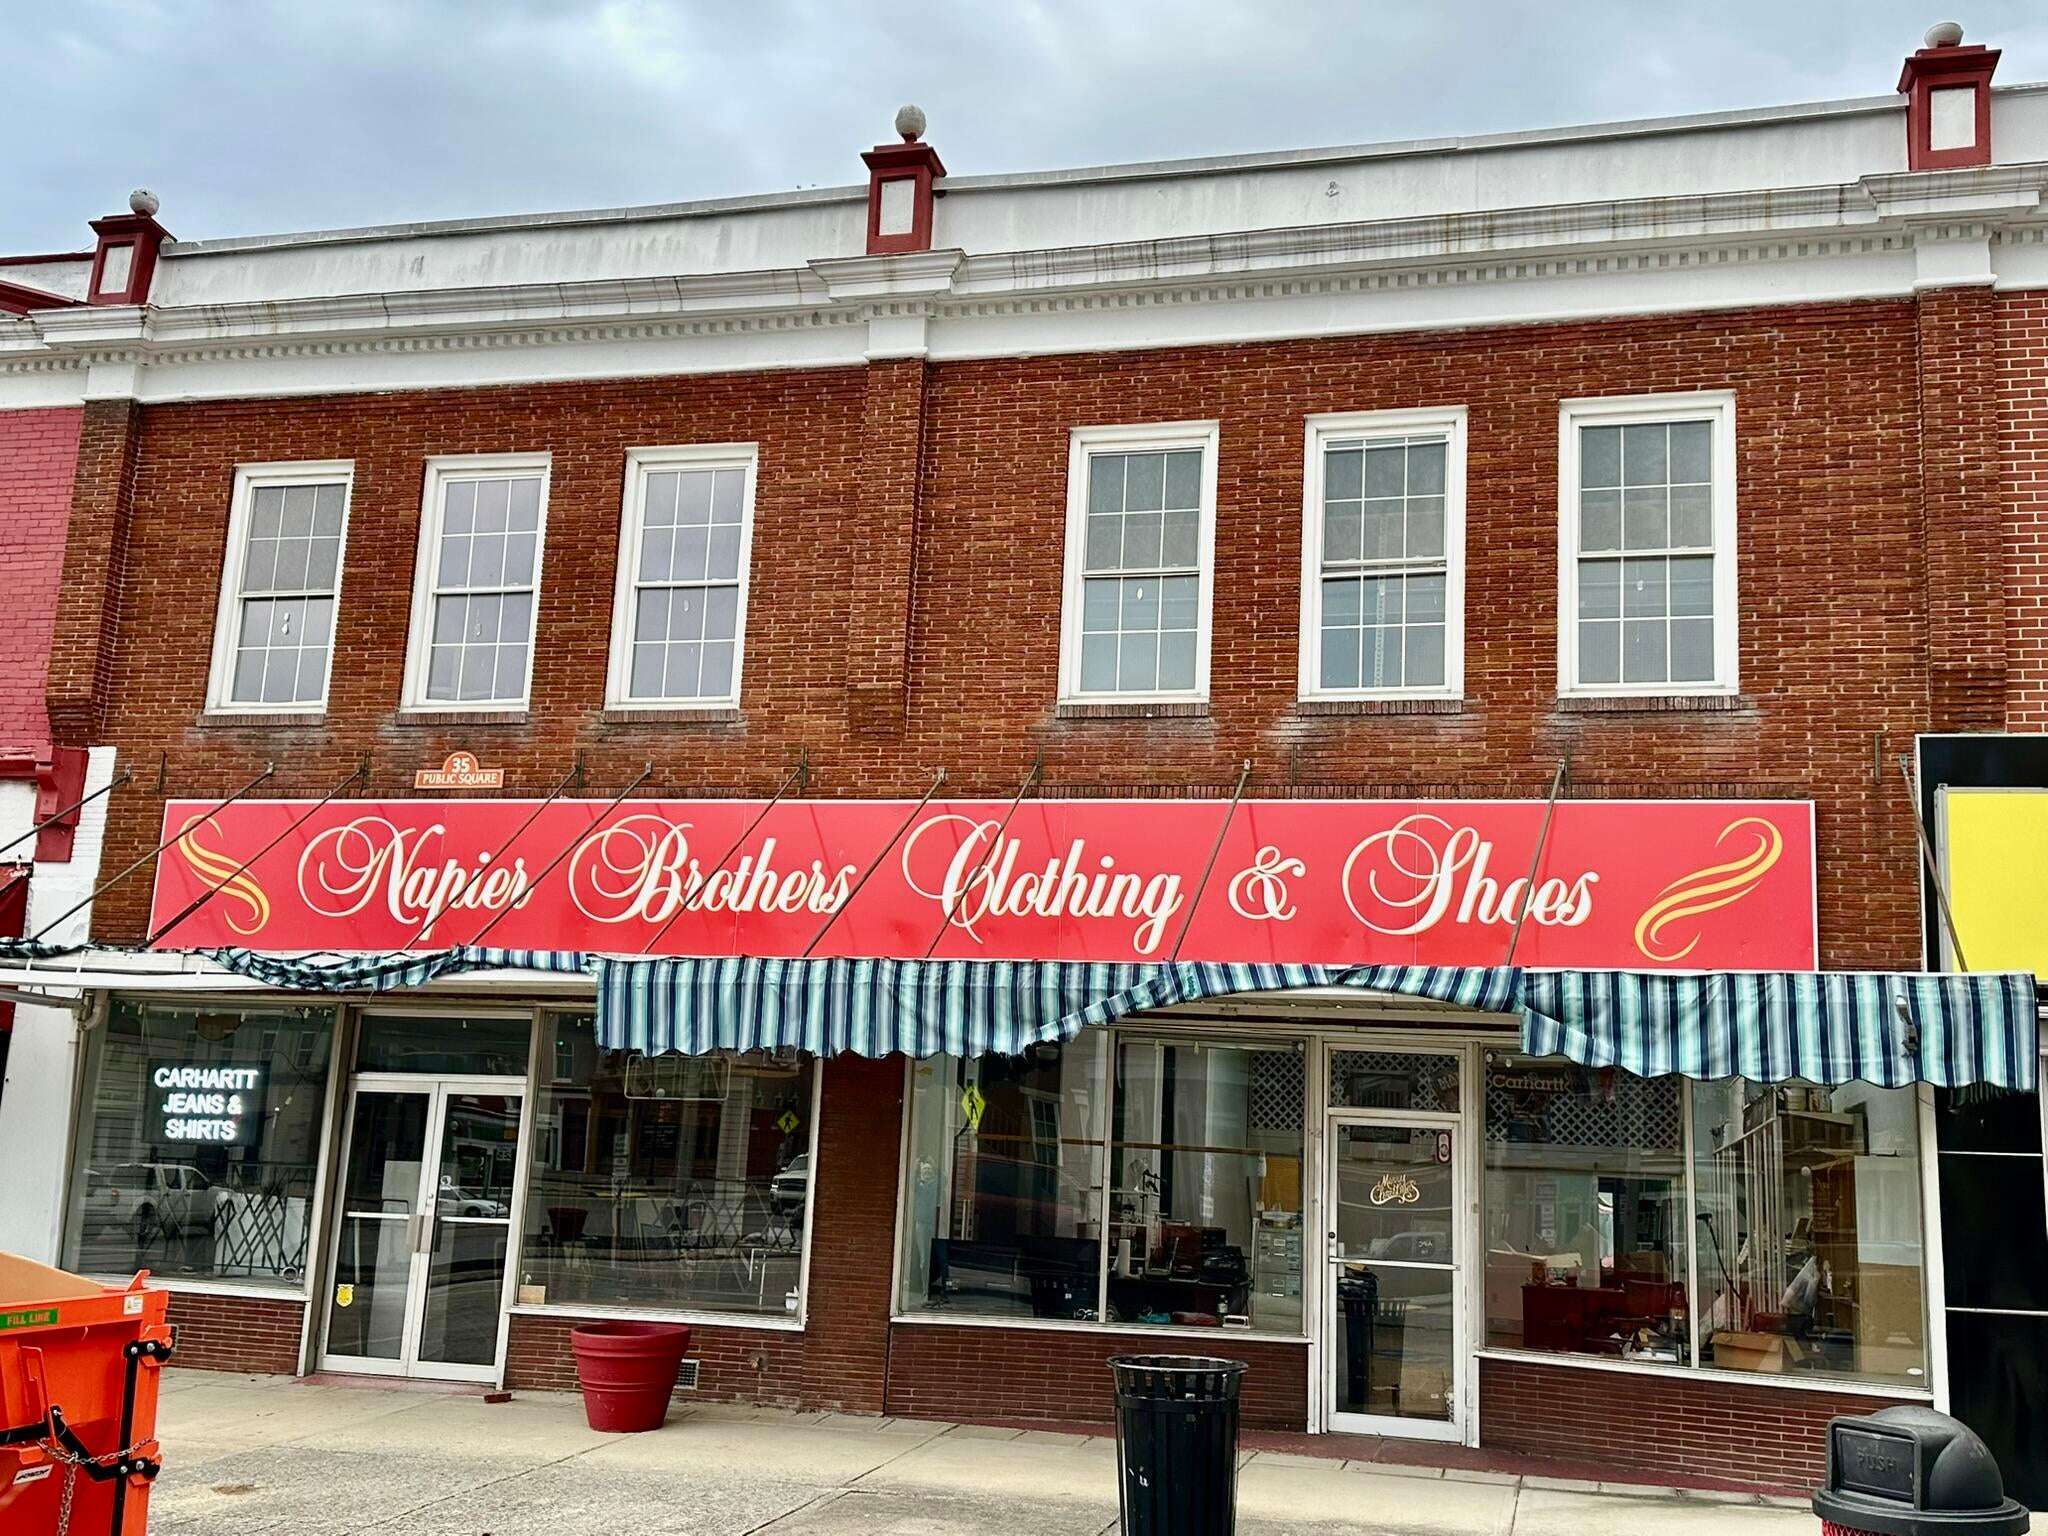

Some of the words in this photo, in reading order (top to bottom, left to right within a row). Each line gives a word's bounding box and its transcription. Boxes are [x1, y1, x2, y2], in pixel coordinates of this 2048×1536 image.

[451, 757, 471, 773] 35
[422, 773, 457, 785] PUBLIC
[457, 772, 498, 786] SQUARE
[297, 815, 534, 941] Napier
[568, 814, 857, 923] Brothers
[901, 813, 1185, 955] Clothing
[1227, 845, 1306, 921] &
[1340, 813, 1600, 936] Shoes
[154, 1067, 259, 1090] CARHARTT
[1492, 1074, 1566, 1092] Carhartt
[162, 1092, 225, 1114] JEANS
[226, 1094, 242, 1115] &
[164, 1118, 237, 1141] SHIRTS
[7, 1314, 27, 1326] FILL
[1856, 1450, 1898, 1472] PUSH
